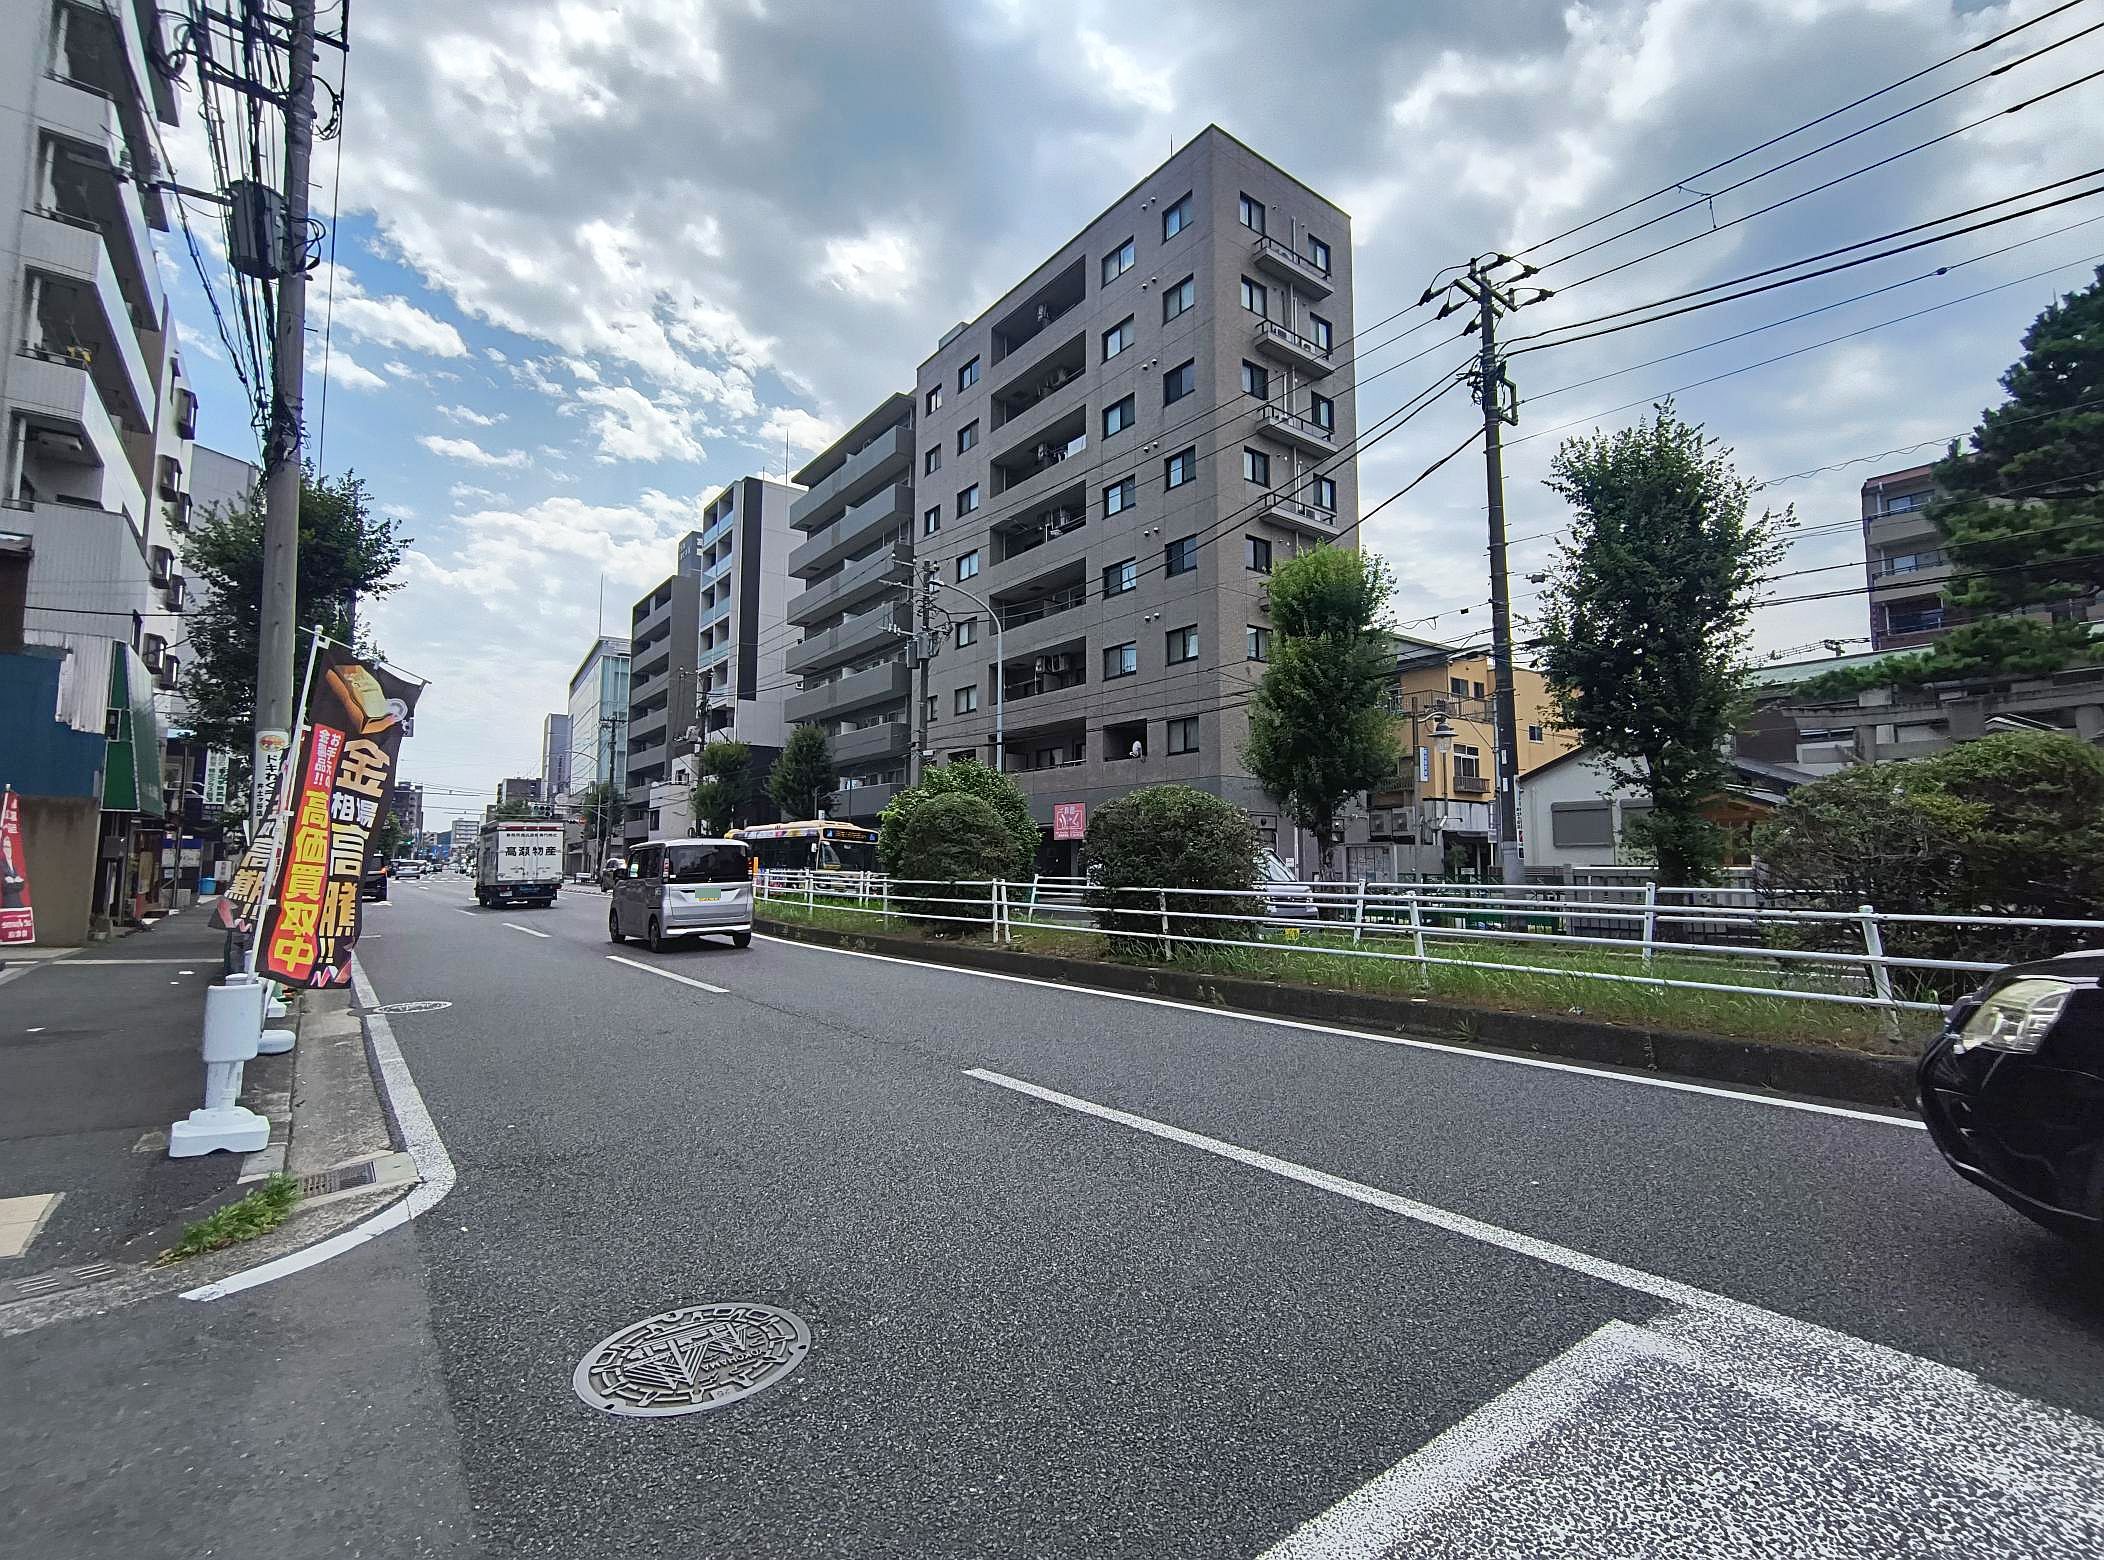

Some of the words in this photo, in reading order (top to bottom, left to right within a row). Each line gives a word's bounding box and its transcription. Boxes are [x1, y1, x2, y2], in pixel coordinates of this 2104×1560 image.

[273, 789, 329, 973] 高価買取中
